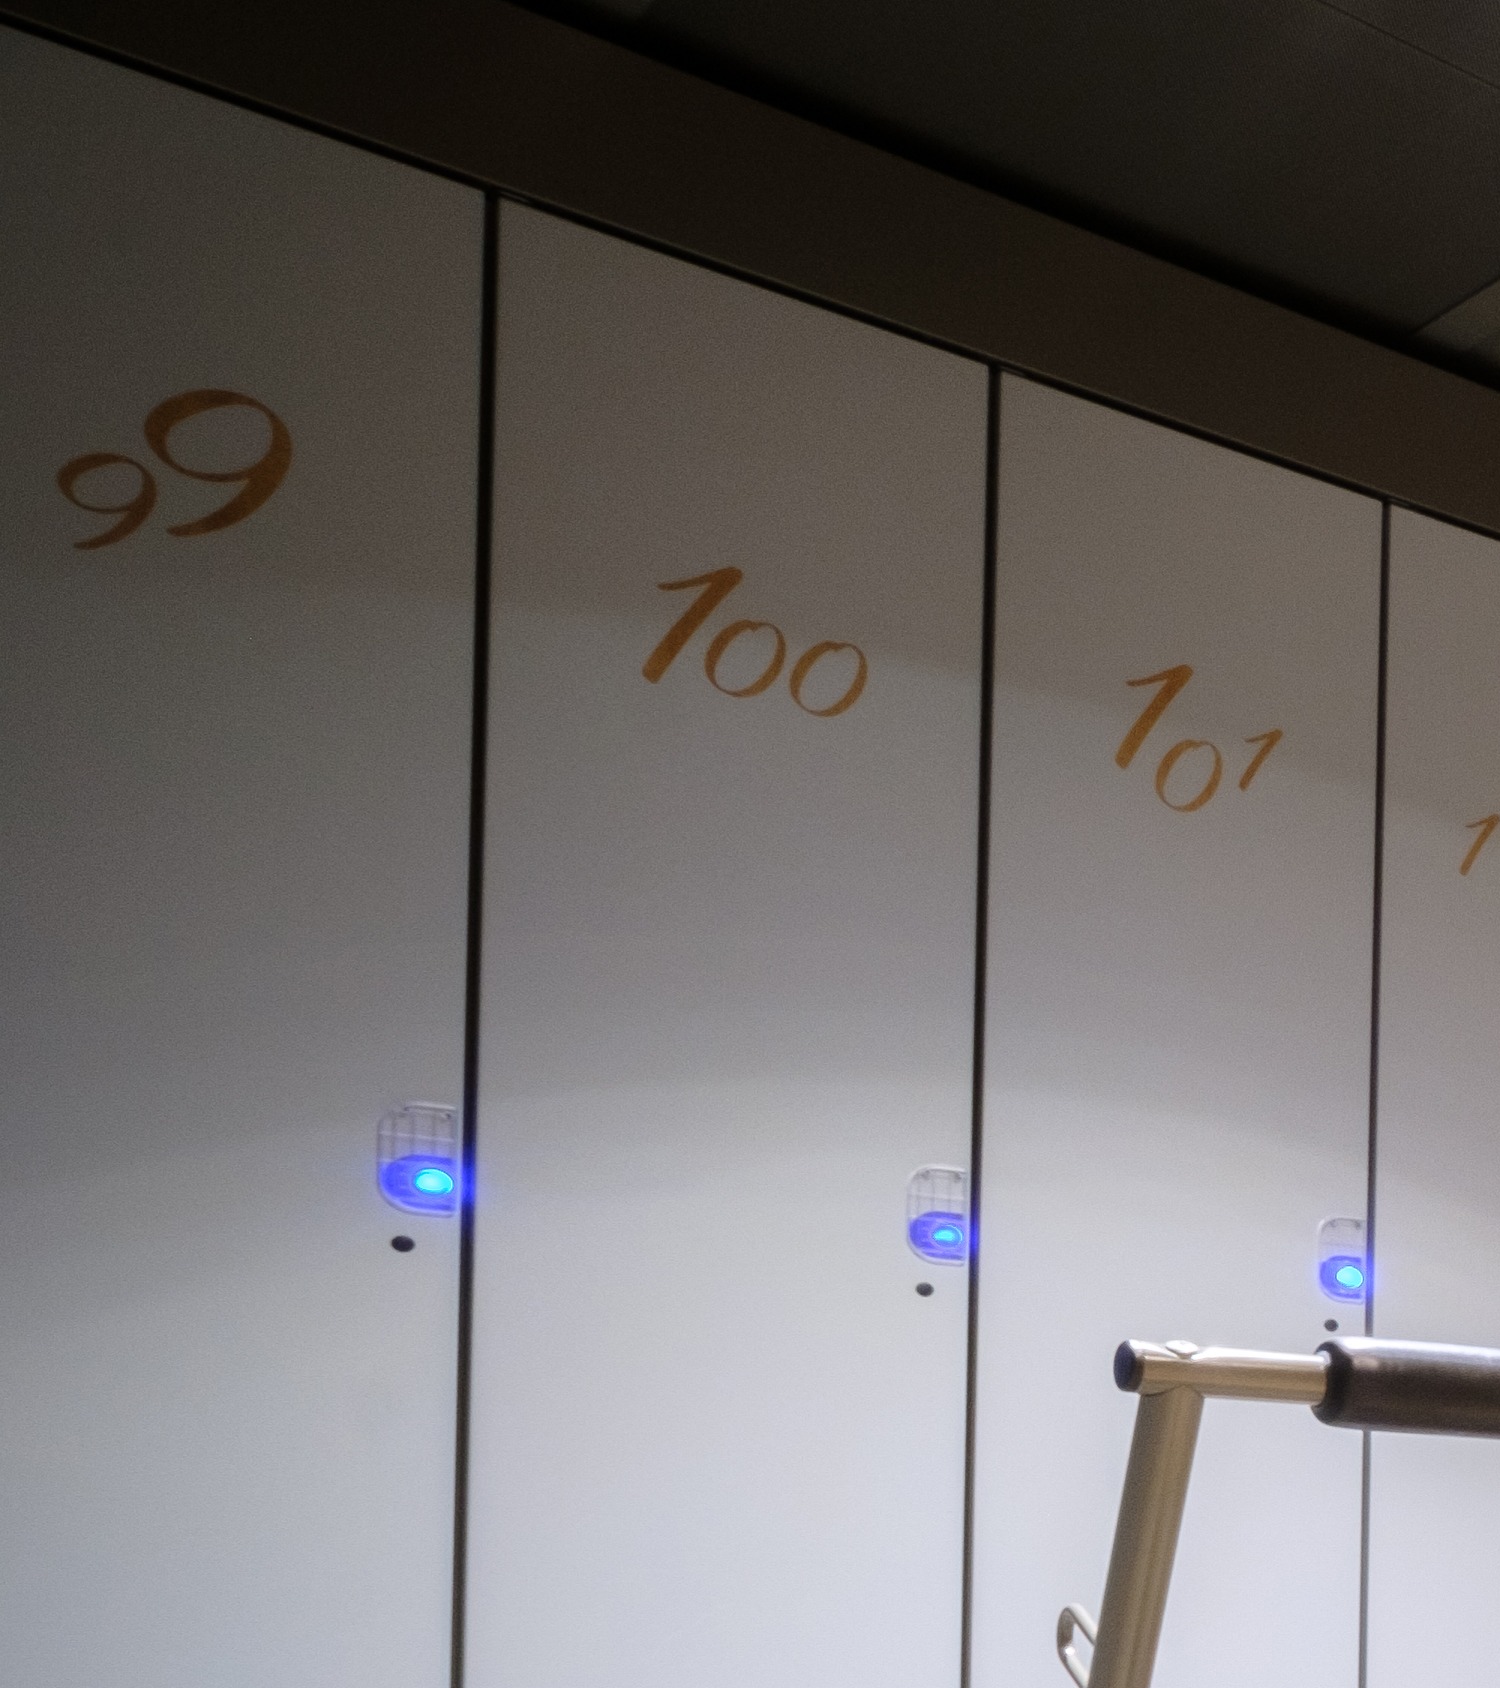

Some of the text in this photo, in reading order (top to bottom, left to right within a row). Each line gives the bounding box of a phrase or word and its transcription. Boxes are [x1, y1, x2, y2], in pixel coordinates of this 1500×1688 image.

[56, 388, 294, 552] 99
[641, 566, 869, 718] 100
[1113, 664, 1283, 813] 101
